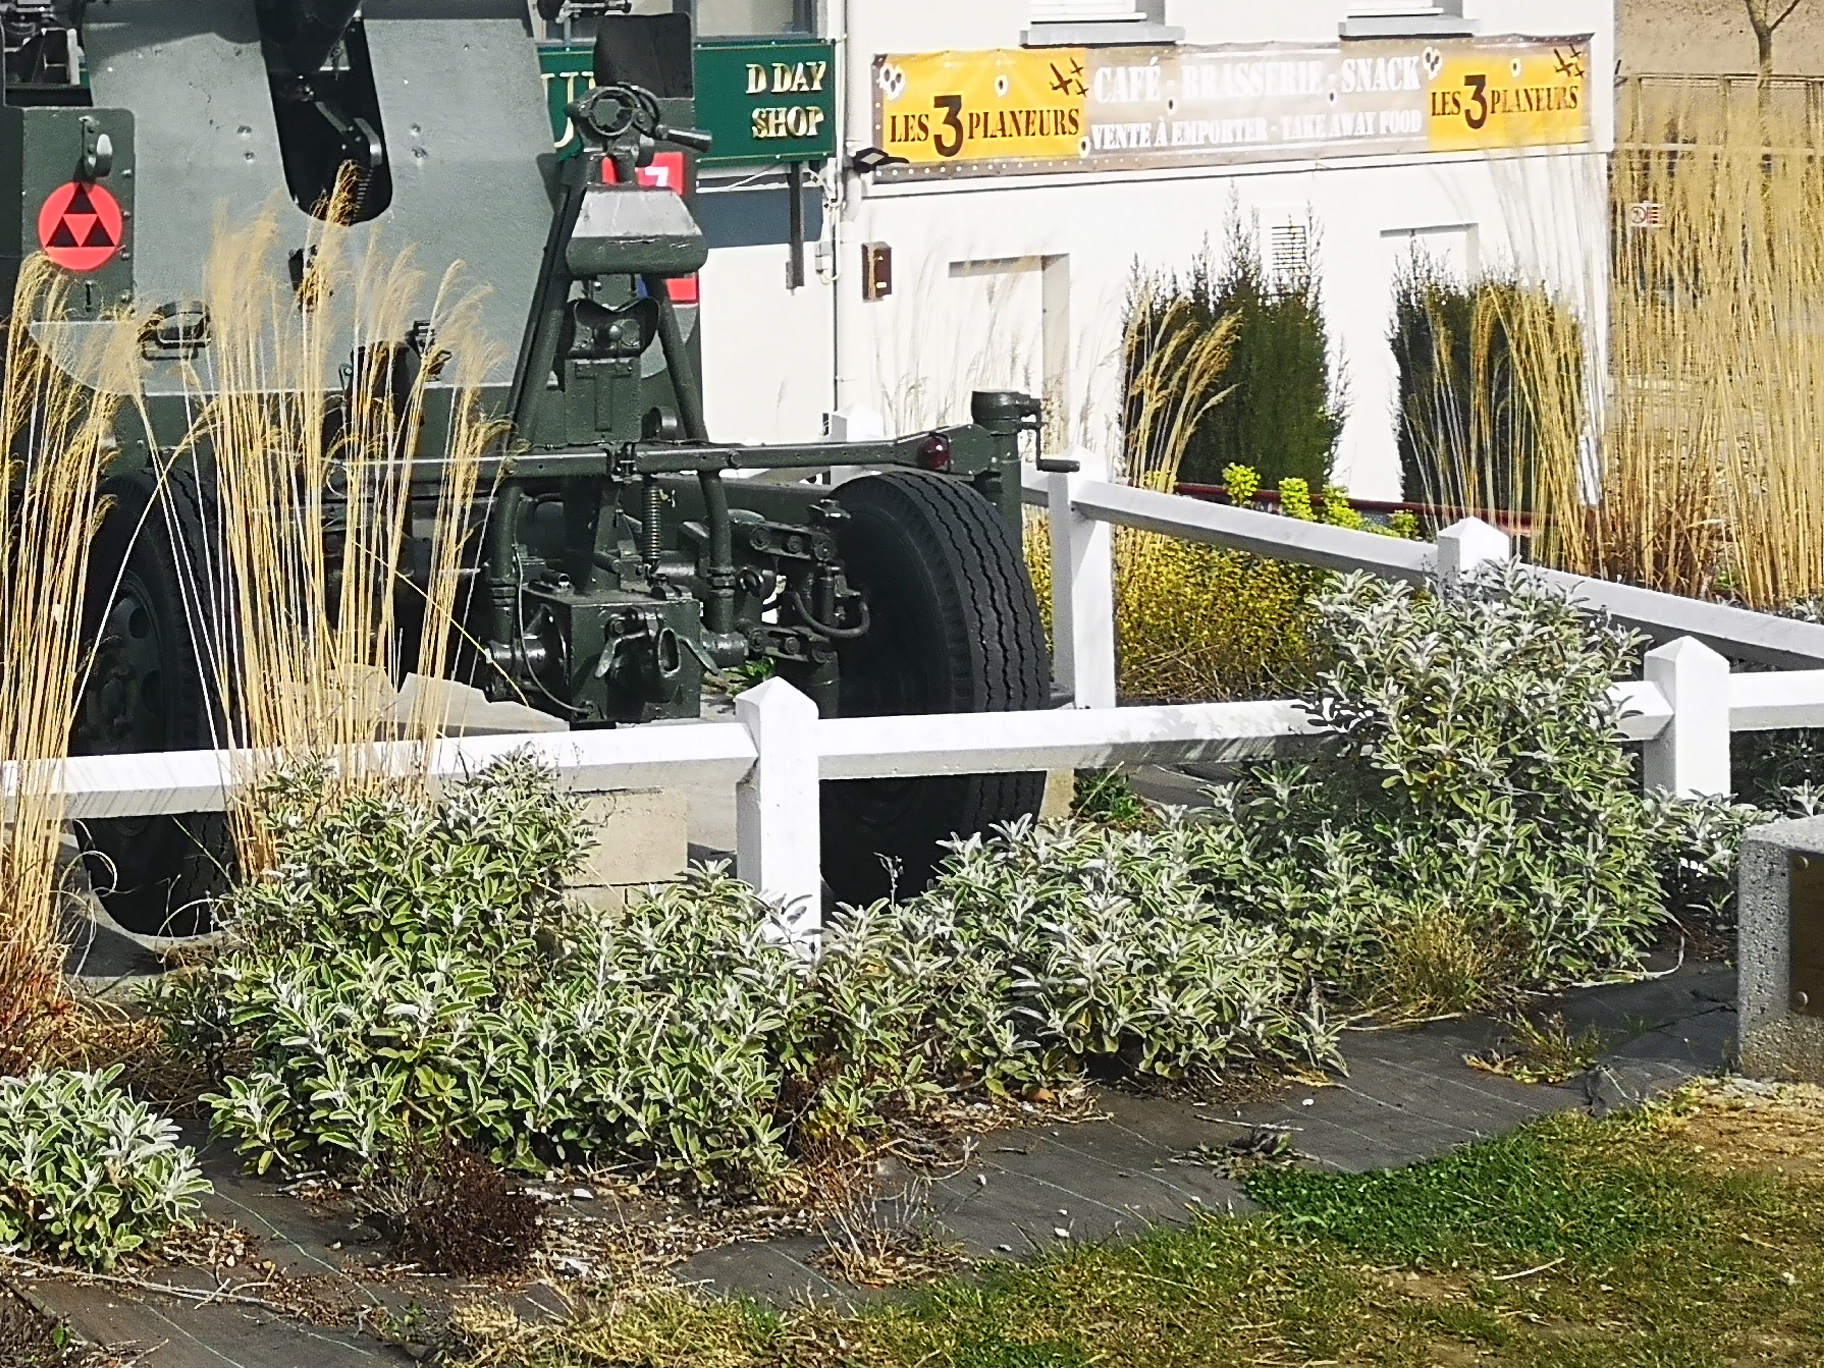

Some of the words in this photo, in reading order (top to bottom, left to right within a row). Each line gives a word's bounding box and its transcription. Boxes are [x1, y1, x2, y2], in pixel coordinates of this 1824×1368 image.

[745, 63, 768, 94] D
[770, 60, 827, 94] DAY
[1094, 56, 1161, 104] CAFÉ
[1181, 59, 1324, 101] BRASSERIE
[1341, 55, 1422, 93] SNACK
[751, 105, 825, 140] SHOP
[1431, 89, 1462, 117] LES
[1464, 74, 1488, 130] 3
[1491, 85, 1579, 115] PLANEURS
[889, 113, 930, 143] LES
[933, 94, 964, 158] 3
[968, 107, 1080, 140] PLANEURS
[1091, 122, 1153, 150] VENTE
[1155, 116, 1171, 147] À
[1172, 117, 1269, 147] EMPORTER
[1280, 114, 1326, 141] TAKE
[1328, 112, 1378, 138] AWAY
[1380, 109, 1424, 134] FOOD
